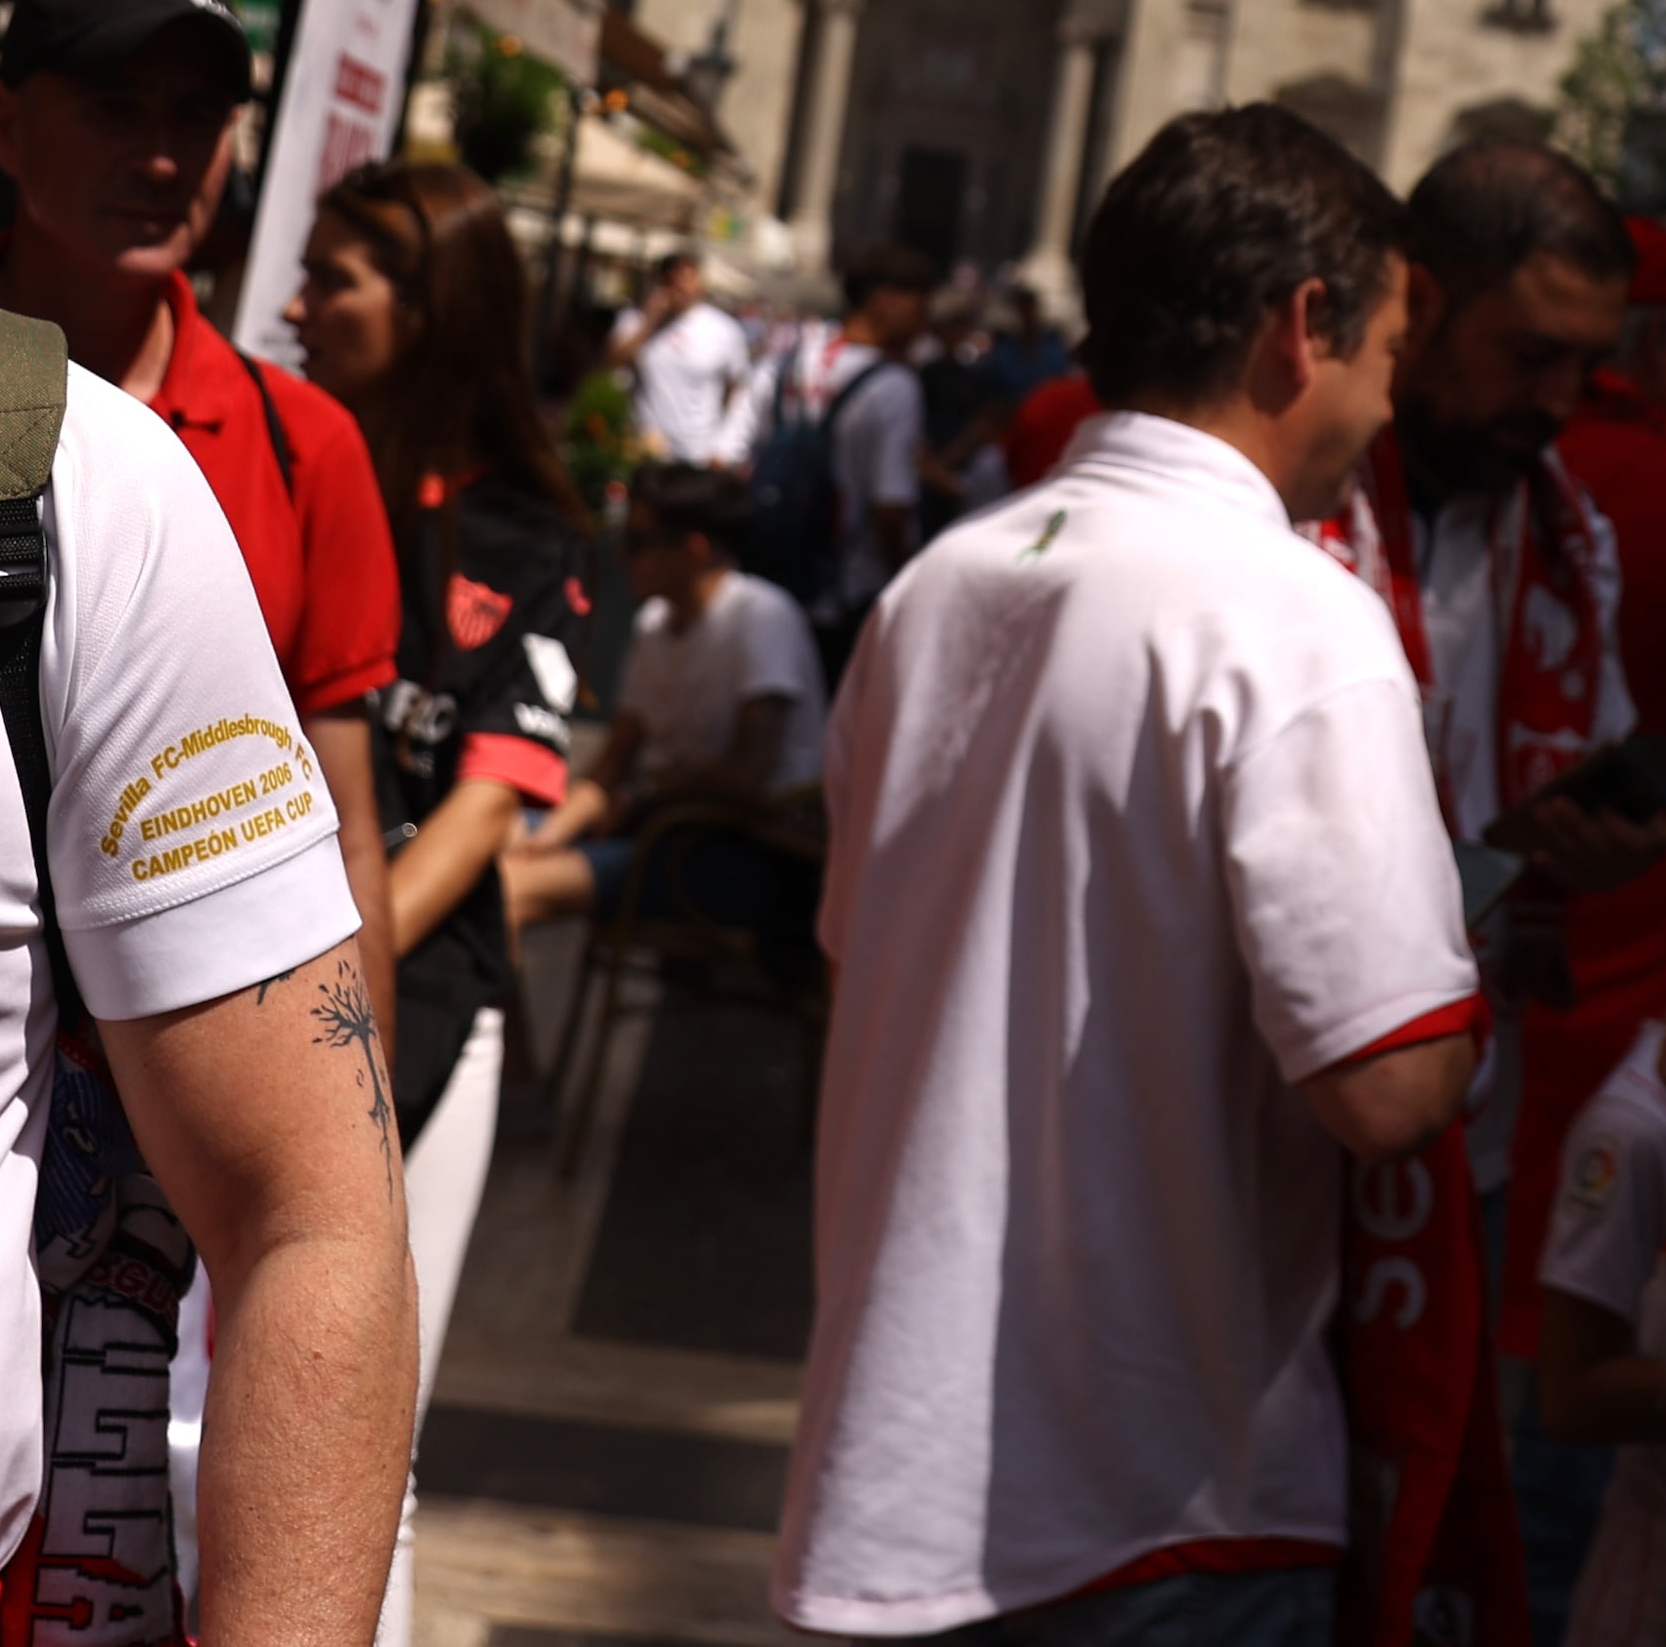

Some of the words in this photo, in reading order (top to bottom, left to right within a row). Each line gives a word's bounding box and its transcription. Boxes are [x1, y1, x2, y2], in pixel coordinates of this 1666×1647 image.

[100, 776, 152, 858] Sevilla
[150, 713, 293, 780] FC-Middlesbrough
[294, 742, 313, 781] FC
[139, 779, 257, 841] EINDHOVEN
[259, 762, 293, 795] 2006
[132, 827, 237, 881] CAMPEÓN
[240, 807, 286, 842] UEFA
[286, 790, 313, 822] CUP
